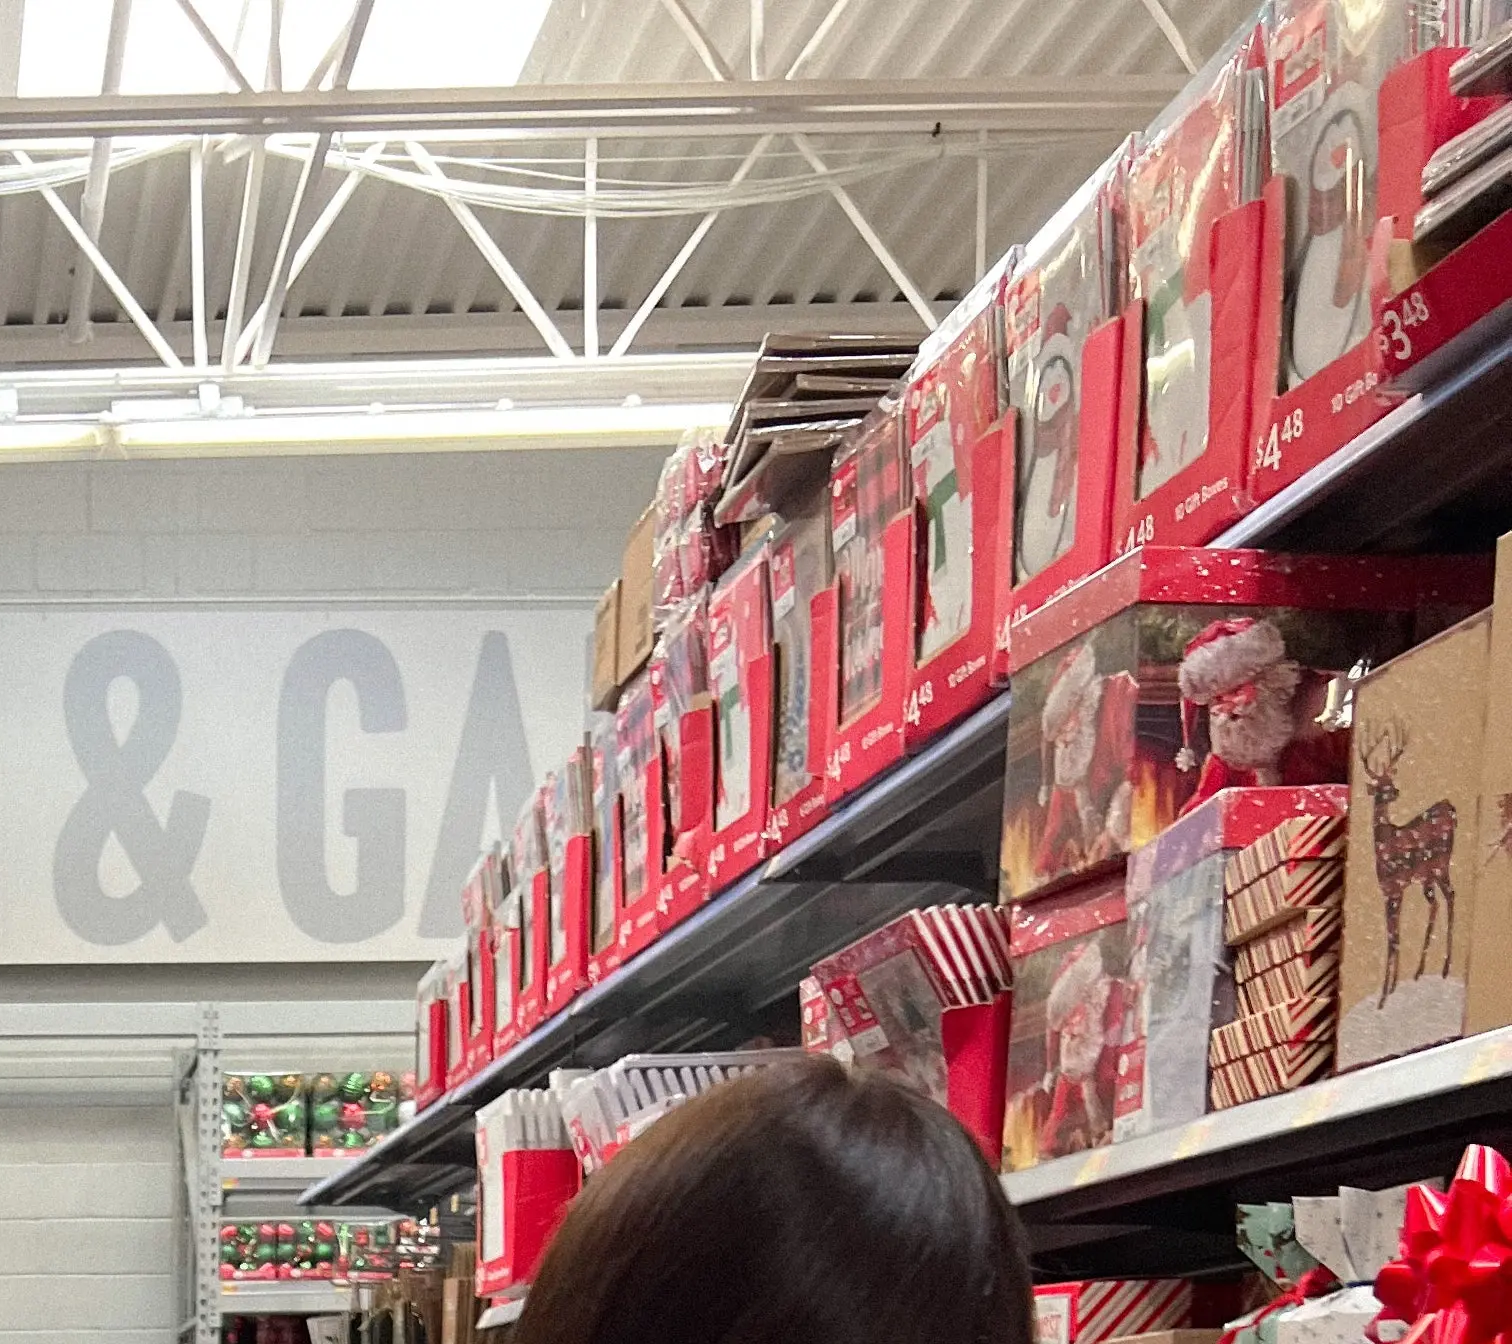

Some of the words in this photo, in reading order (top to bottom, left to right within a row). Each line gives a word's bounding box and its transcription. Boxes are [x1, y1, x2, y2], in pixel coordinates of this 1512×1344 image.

[1254, 407, 1304, 471] $448
[52, 628, 210, 946] &
[275, 627, 594, 945] GA
